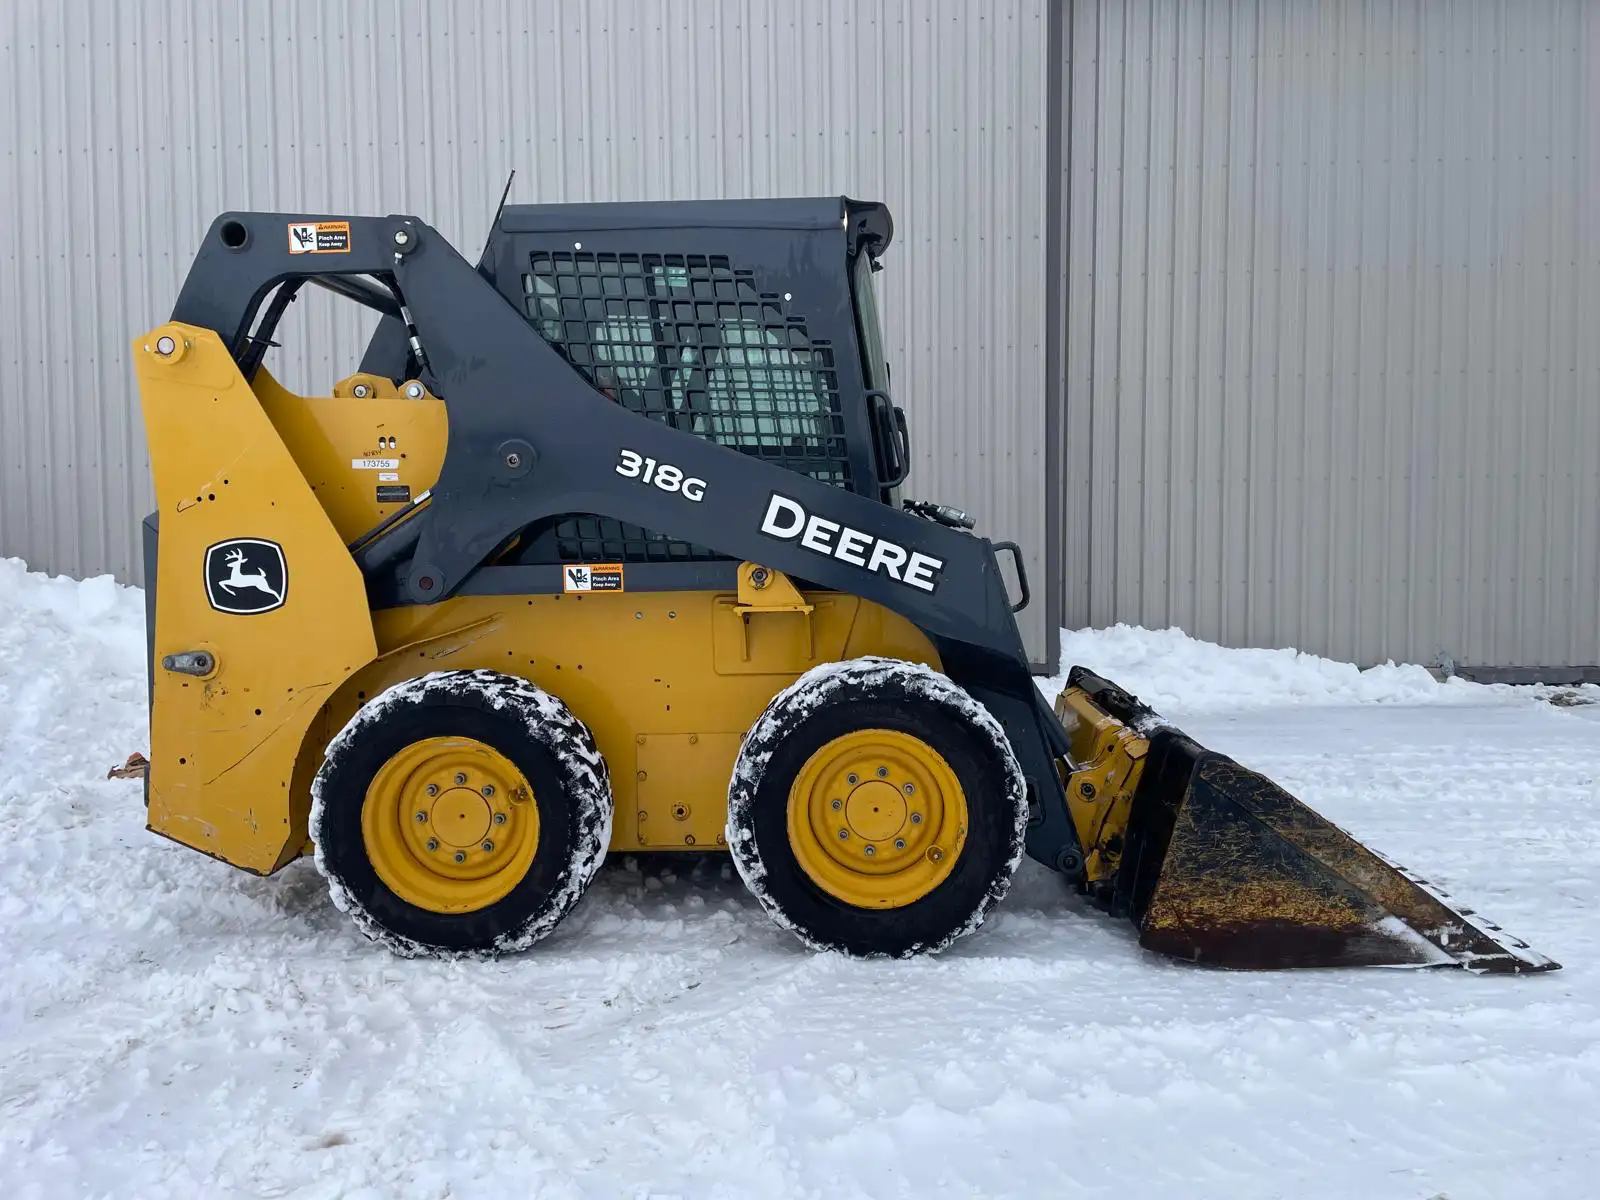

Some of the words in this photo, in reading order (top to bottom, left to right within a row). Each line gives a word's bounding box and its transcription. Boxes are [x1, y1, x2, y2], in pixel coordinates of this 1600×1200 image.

[362, 460, 390, 468] 173755
[615, 449, 708, 502] 318G
[761, 494, 943, 591] DEERE
